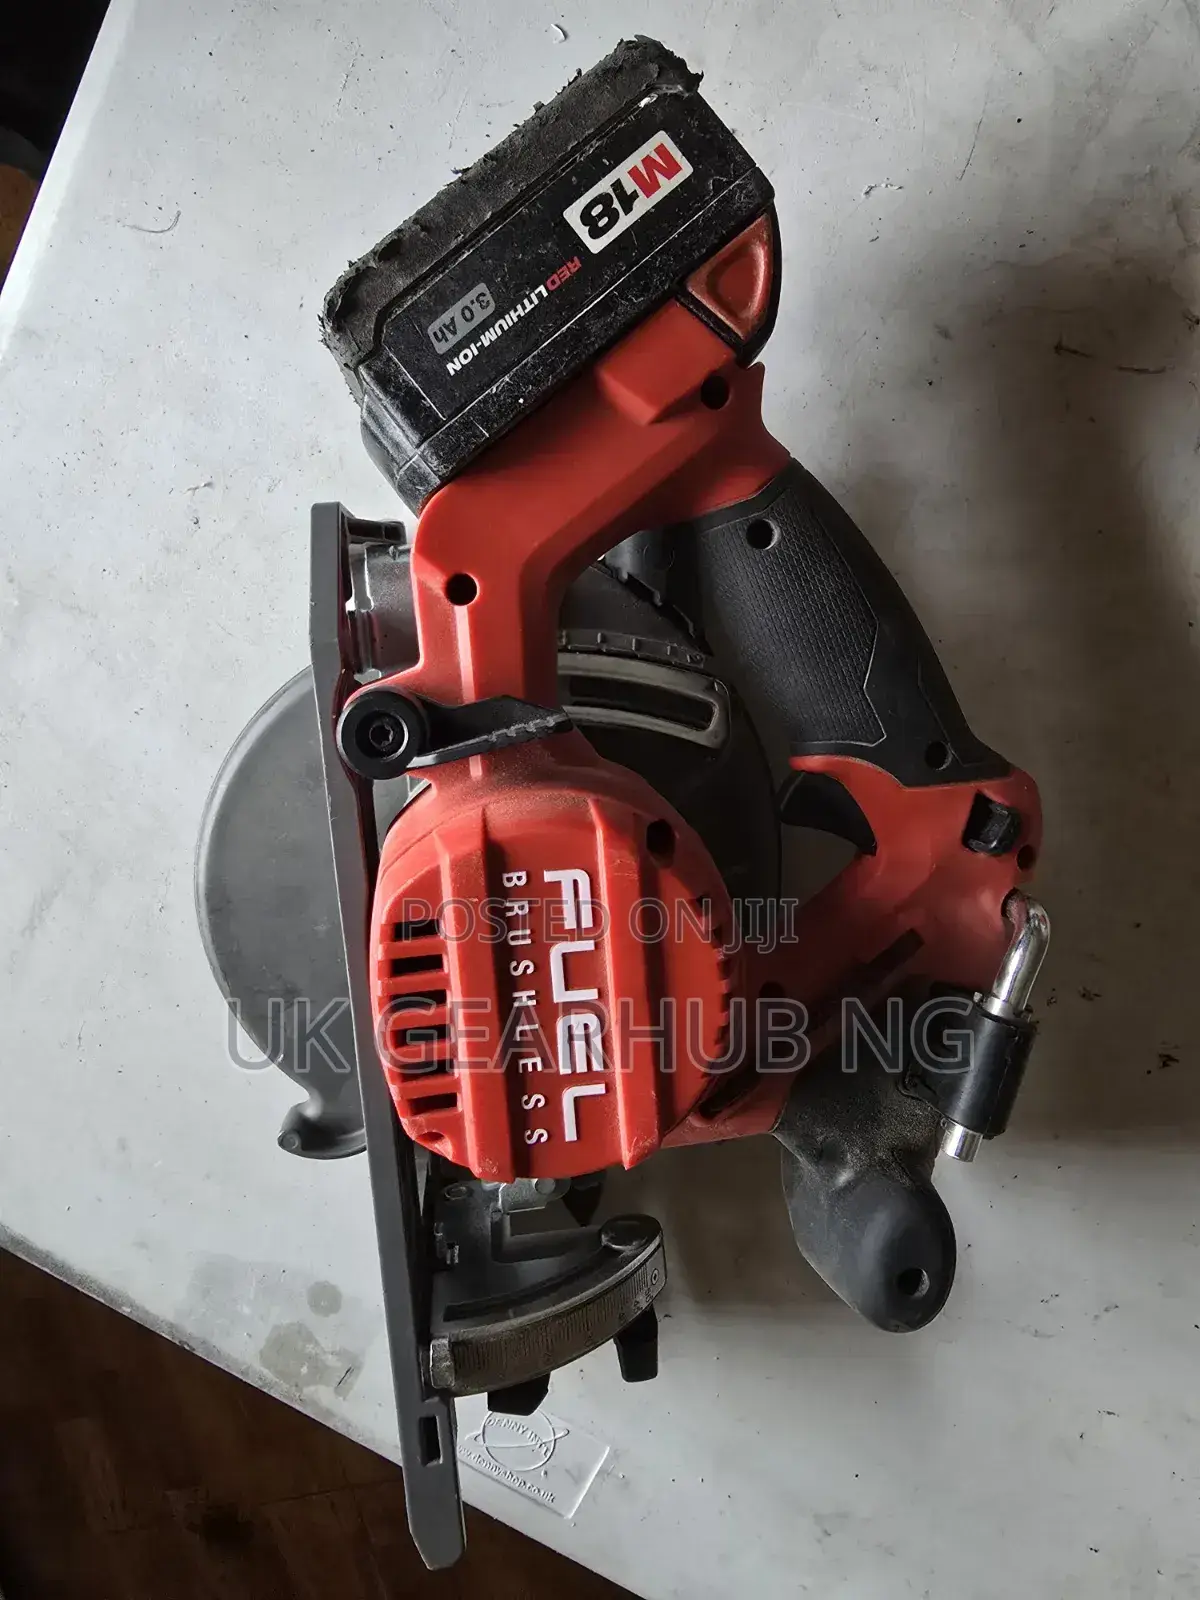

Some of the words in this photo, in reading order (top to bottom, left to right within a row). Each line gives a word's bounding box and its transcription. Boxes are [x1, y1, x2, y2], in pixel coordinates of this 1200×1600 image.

[579, 142, 684, 240] M18
[546, 256, 582, 292] RED
[433, 316, 458, 344] Ah
[446, 284, 549, 377] LITHIUM-ION
[461, 292, 491, 323] 3.0
[502, 870, 549, 1146] BRUSHLESS
[543, 868, 607, 1143] FUEL
[487, 1417, 529, 1436] DENNY
